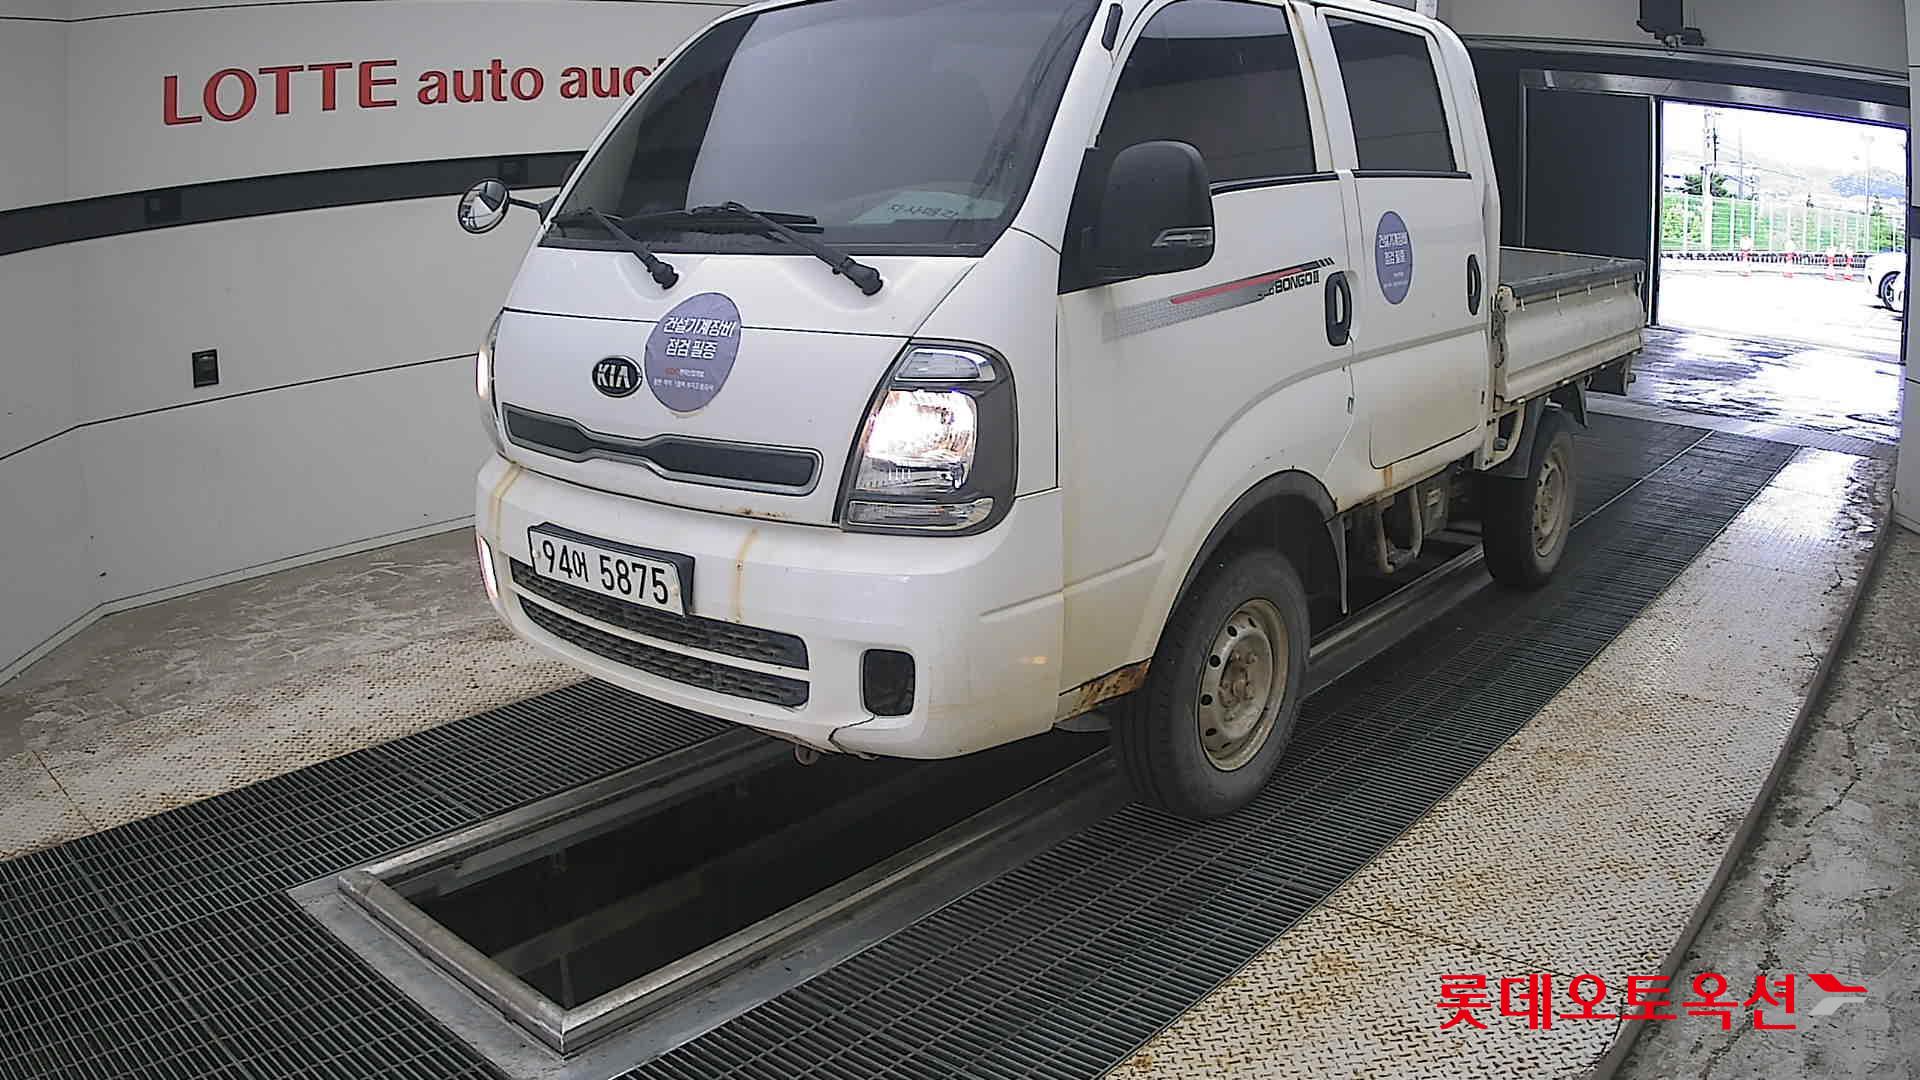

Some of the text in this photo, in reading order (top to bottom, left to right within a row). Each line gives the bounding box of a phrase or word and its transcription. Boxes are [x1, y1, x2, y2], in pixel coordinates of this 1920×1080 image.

[163, 58, 667, 126] LOTTE auto auc
[1275, 271, 1313, 293] BONGO
[663, 317, 737, 337] 건설기계장비
[666, 338, 718, 359] 점검 필증
[597, 363, 631, 388] KIA
[542, 540, 669, 605] 94어 5875
